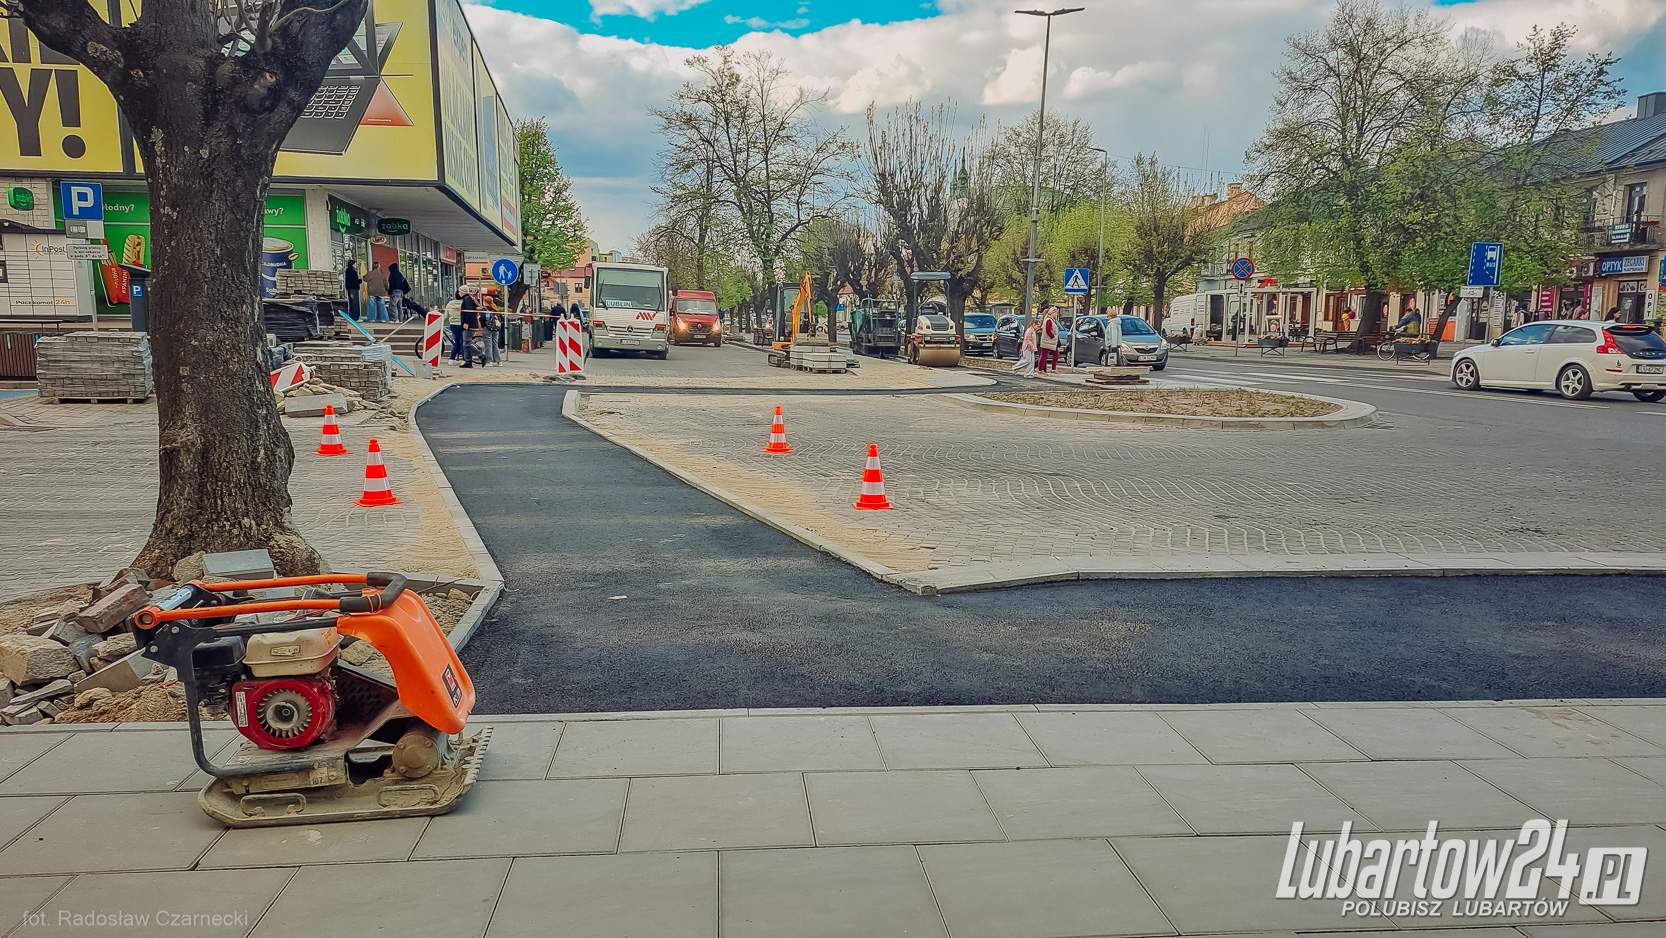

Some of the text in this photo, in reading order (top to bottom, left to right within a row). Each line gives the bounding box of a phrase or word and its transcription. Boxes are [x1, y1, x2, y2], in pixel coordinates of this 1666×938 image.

[71, 186, 94, 215] P
[104, 203, 135, 213] łodny?
[1602, 261, 1622, 271] OPTYK
[133, 286, 141, 295] P
